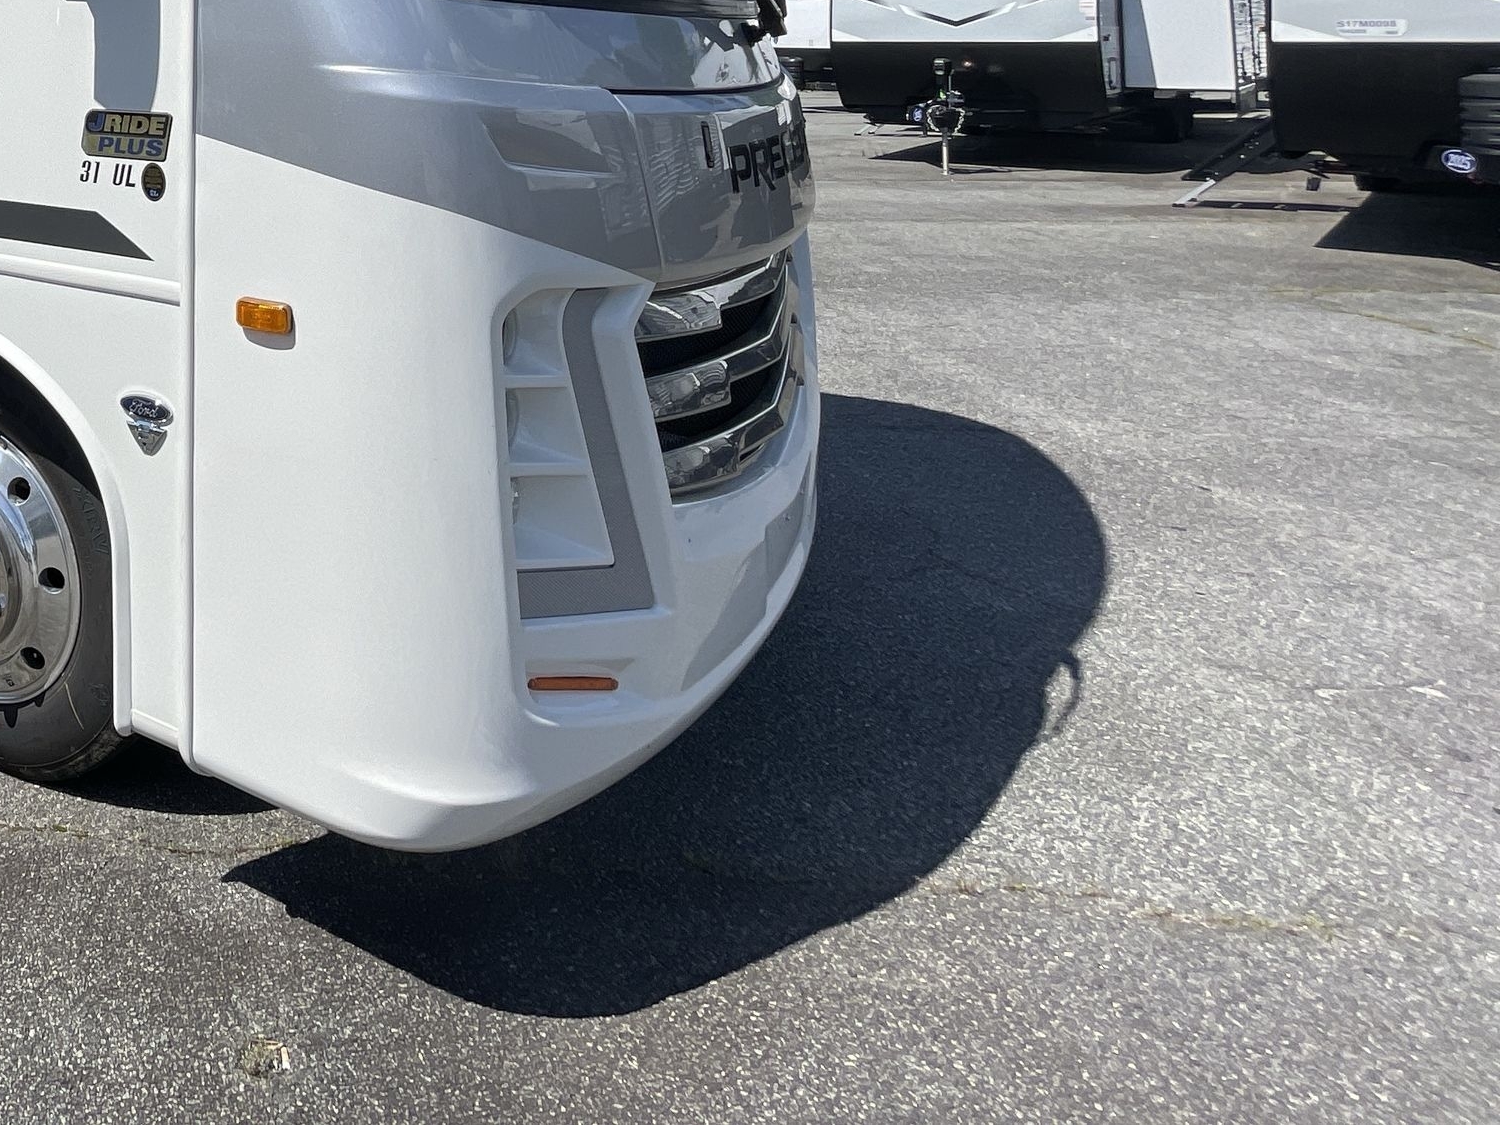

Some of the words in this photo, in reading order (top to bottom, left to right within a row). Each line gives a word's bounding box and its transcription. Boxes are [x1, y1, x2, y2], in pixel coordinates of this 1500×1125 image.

[87, 112, 166, 135] JRIDE
[98, 136, 164, 157] PLUS
[79, 160, 100, 184] 31
[112, 163, 136, 187] UL
[129, 399, 159, 417] Ford
